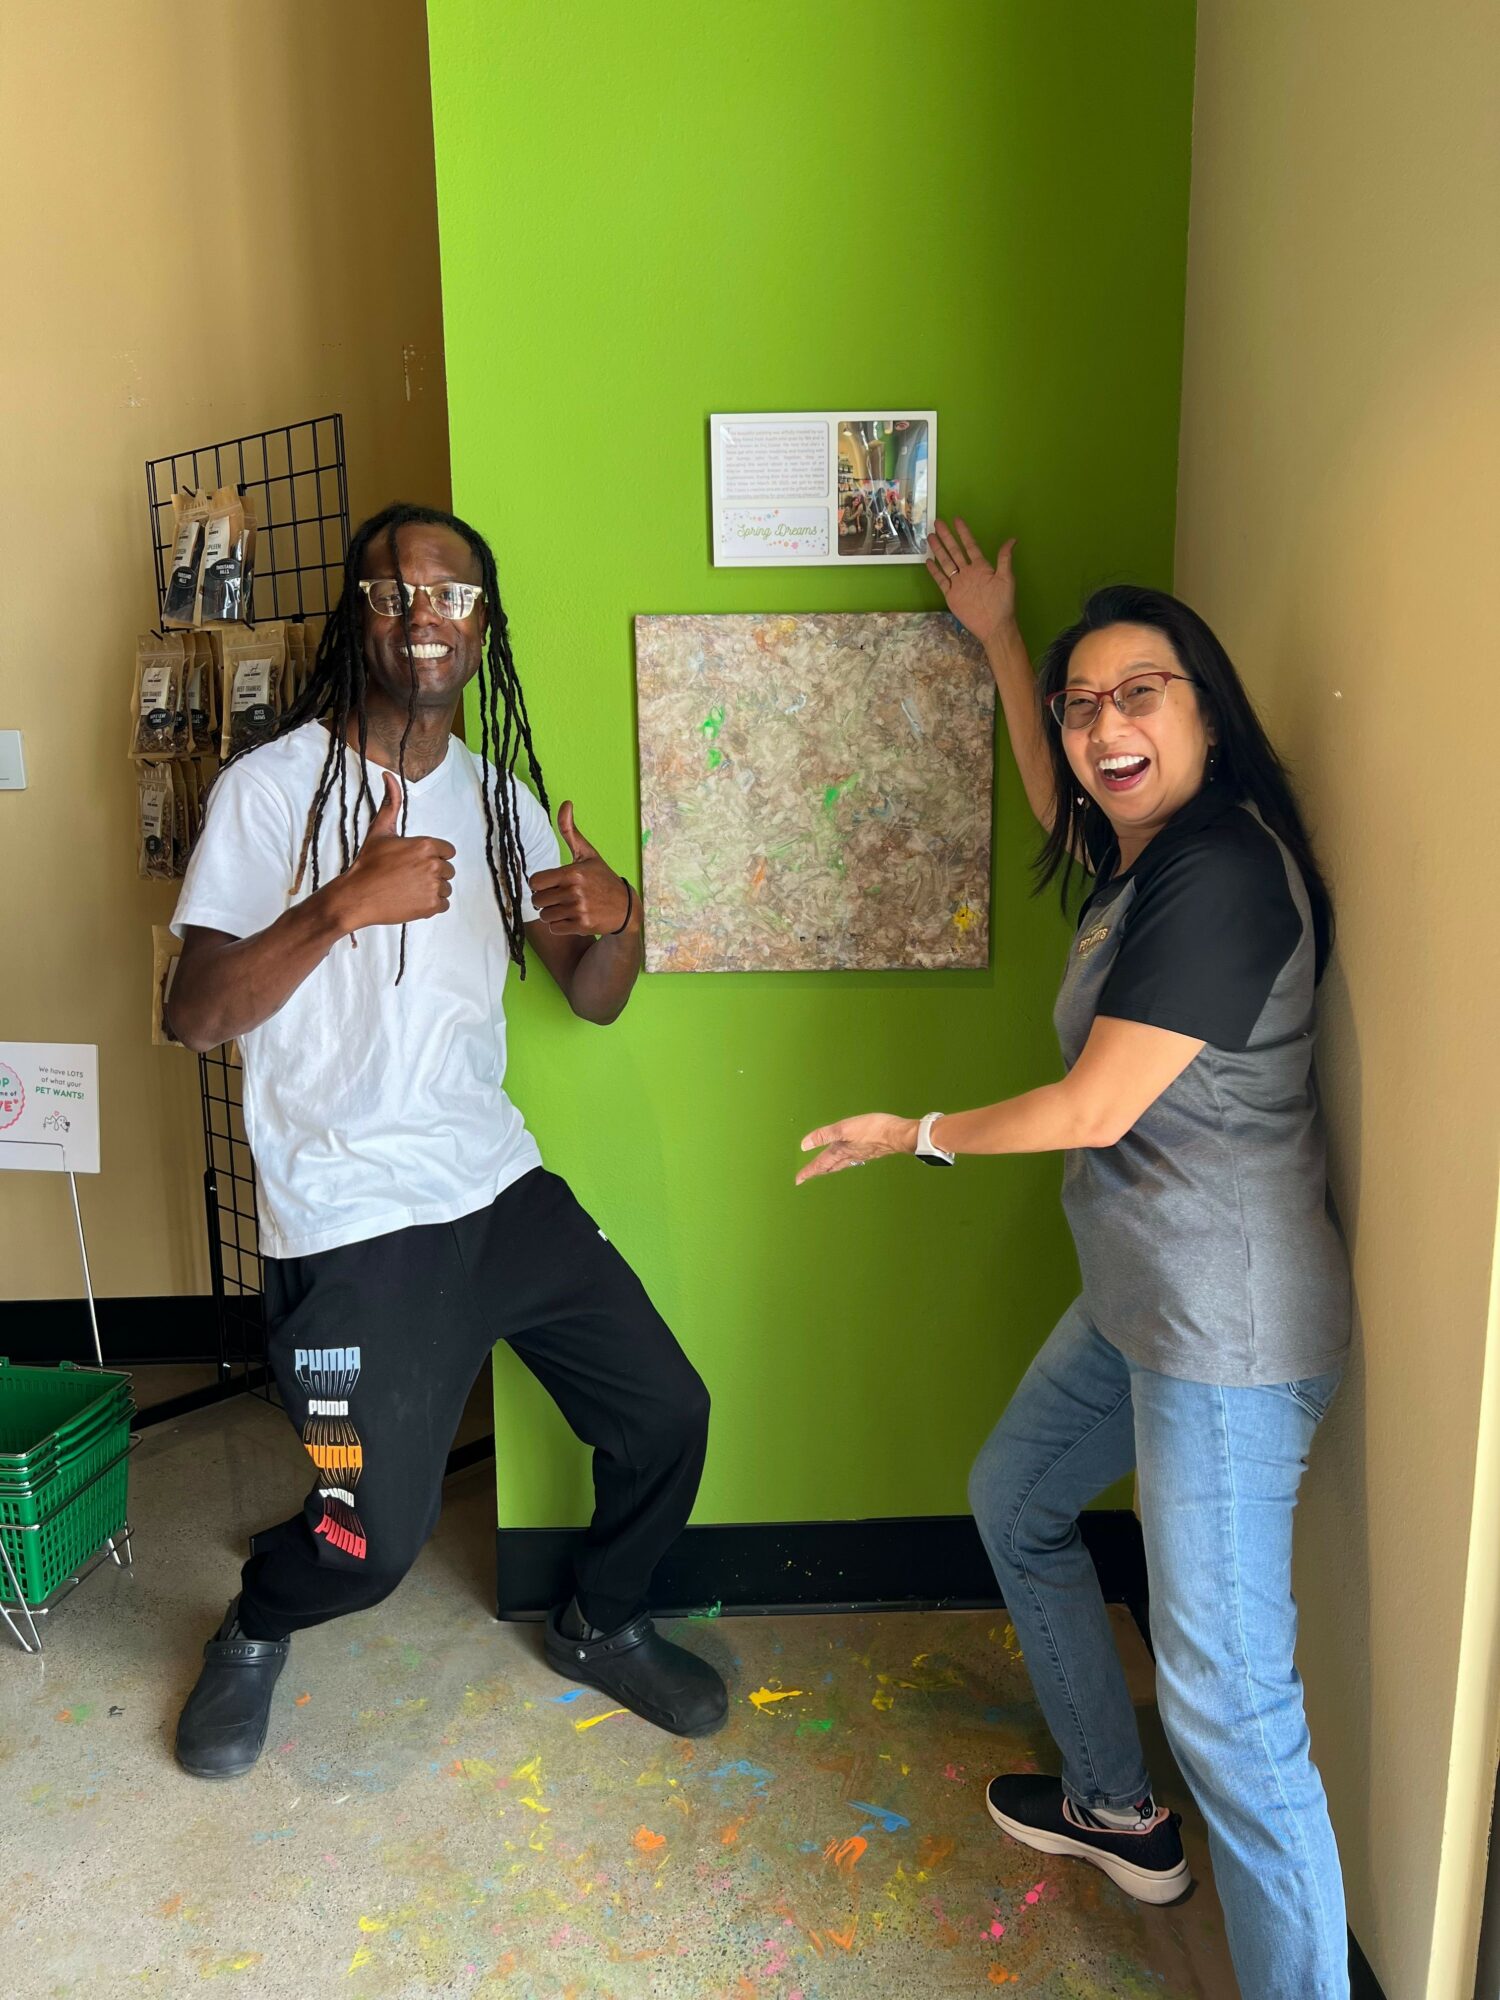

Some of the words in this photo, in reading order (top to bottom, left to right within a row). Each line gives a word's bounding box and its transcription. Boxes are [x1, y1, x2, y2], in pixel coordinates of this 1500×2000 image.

[737, 524, 772, 540] Spring
[775, 523, 817, 537] Dreams
[39, 1066, 49, 1074] We
[50, 1067, 66, 1076] have
[67, 1070, 84, 1078] LOTS
[50, 1078, 66, 1086] what
[36, 1086, 51, 1095] PET
[53, 1088, 85, 1100] WANTS!
[295, 1346, 361, 1371] PUMA
[308, 1399, 349, 1416] PUMA
[319, 1487, 355, 1508] PUMA
[314, 1513, 367, 1560] PUMA
